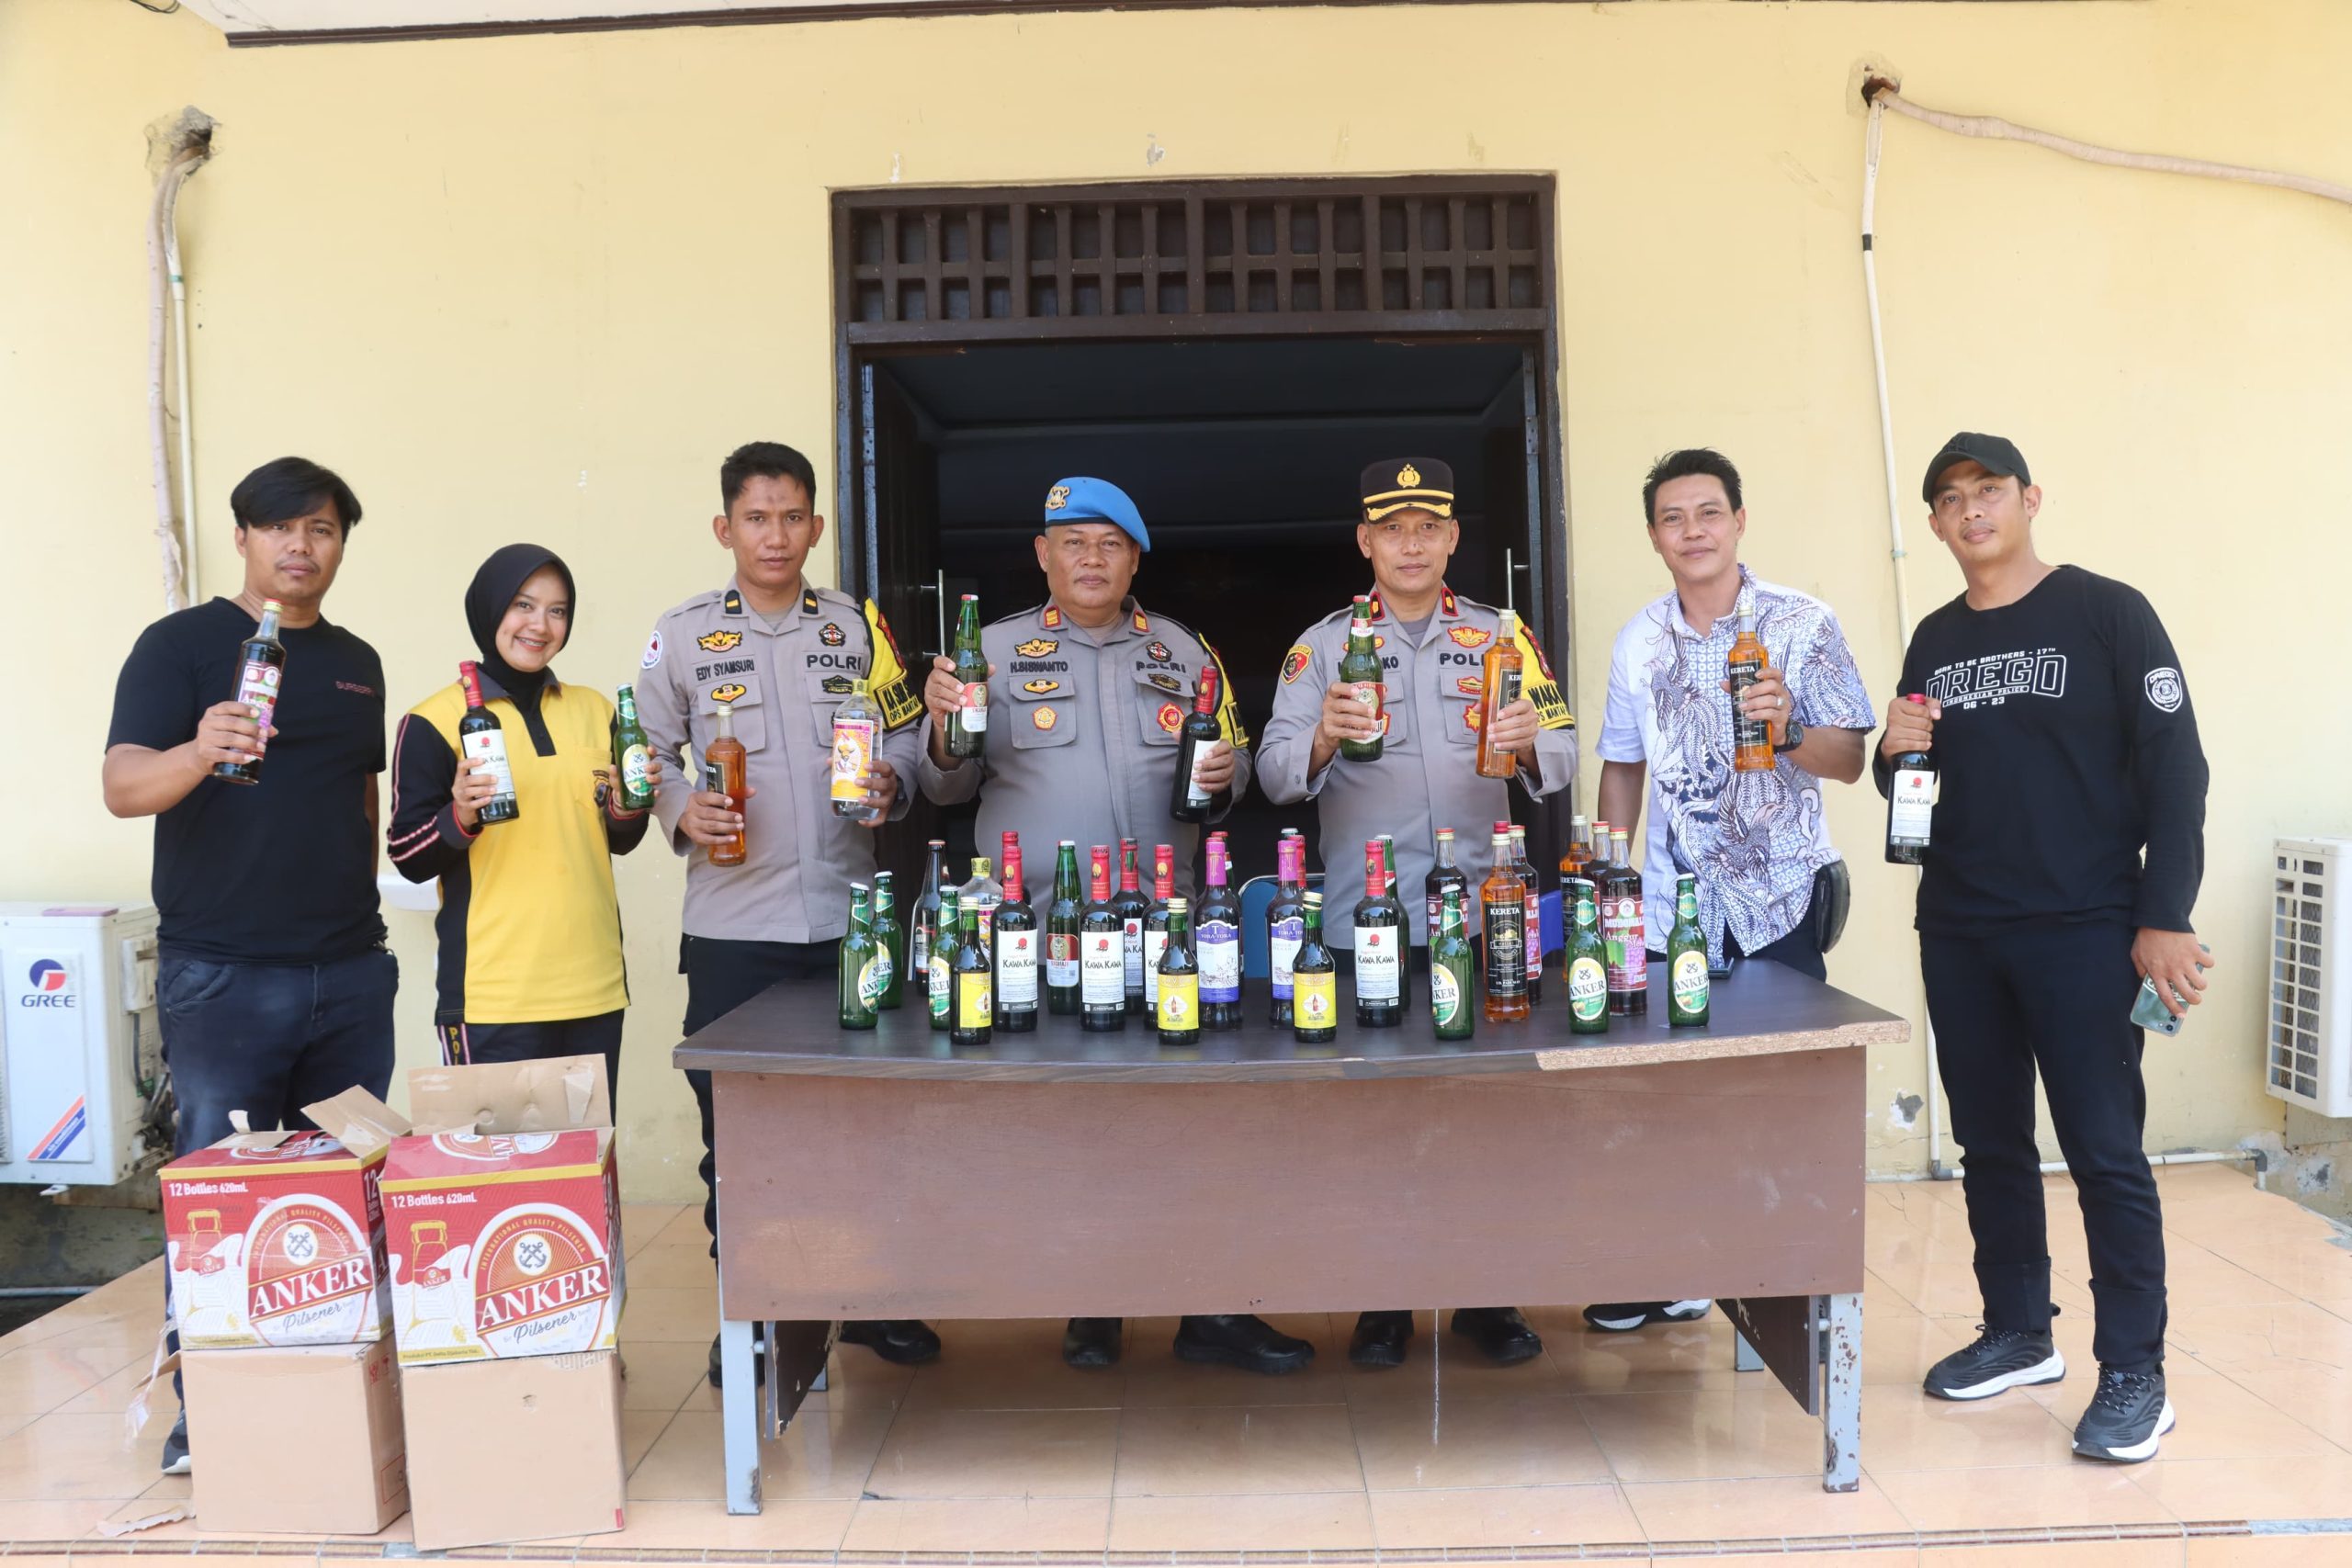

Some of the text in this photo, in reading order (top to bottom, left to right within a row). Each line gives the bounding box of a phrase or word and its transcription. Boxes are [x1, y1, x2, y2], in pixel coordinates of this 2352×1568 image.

[807, 654, 862, 671] POLRI
[1439, 652, 1485, 667] POL
[1980, 650, 2025, 664] BROTHERS
[695, 659, 755, 682] EDY SYAMSURI
[1136, 660, 1187, 673] POLRI
[1997, 685, 2025, 694] POLICE
[1991, 696, 2006, 706] 23
[624, 767, 647, 780] ANK
[1489, 907, 1521, 916] KERETA
[1002, 959, 1023, 968] KAWA
[1084, 960, 1122, 969] KAWA KAWA
[1358, 955, 1395, 964] KAWA KAWA
[1675, 974, 1709, 991] ANKER
[20, 994, 77, 1009] GREE
[169, 1181, 249, 1197] 12 Bottles 620mL
[391, 1192, 478, 1209] 12 Bottles 620mL
[290, 1209, 322, 1217] QUALITY
[480, 1217, 587, 1271] INTERNATIONAL QUALITY PILSENER
[249, 1257, 370, 1319] ANKER
[477, 1265, 607, 1331] ANKER
[283, 1302, 343, 1333] Pilsener
[513, 1311, 578, 1345] Pilsener
